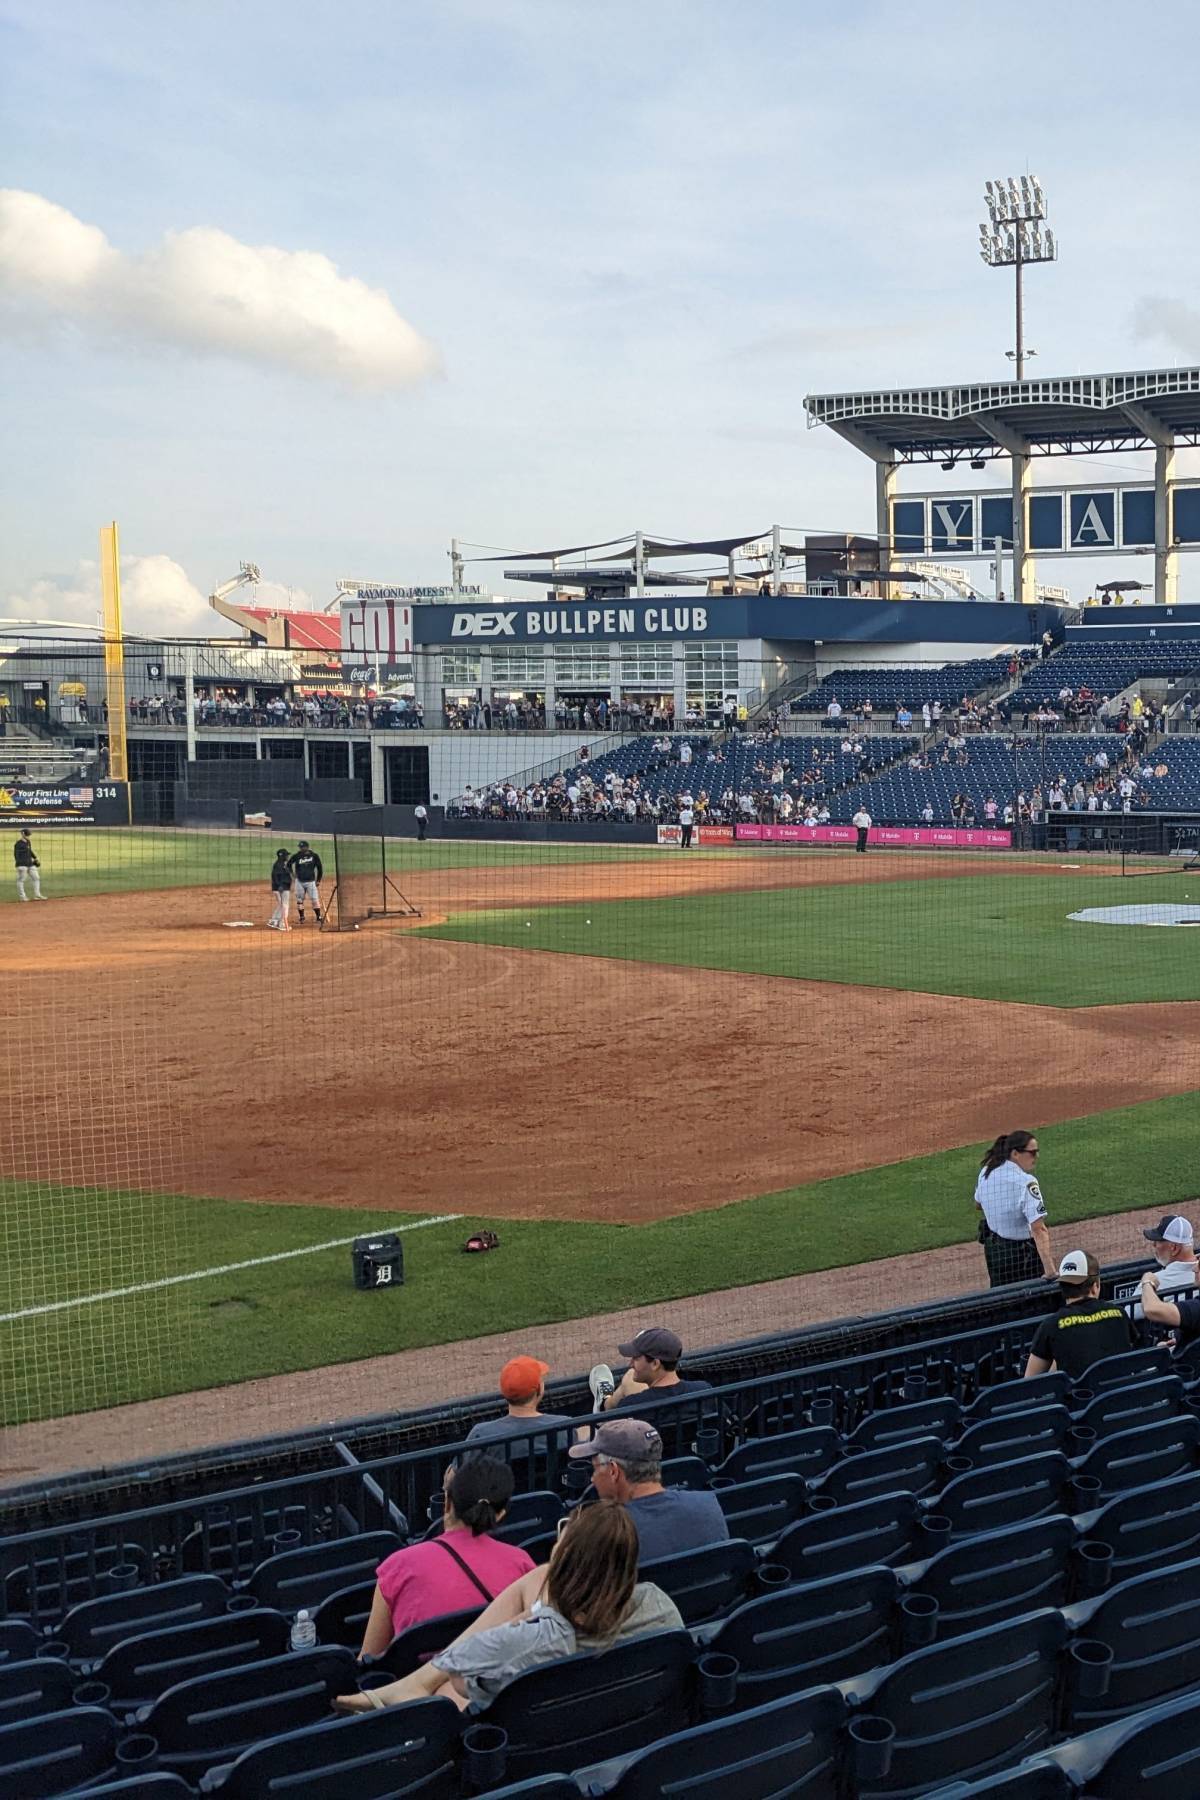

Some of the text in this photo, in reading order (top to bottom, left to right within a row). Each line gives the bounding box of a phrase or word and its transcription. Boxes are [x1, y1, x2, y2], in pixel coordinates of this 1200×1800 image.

[358, 588, 404, 598] RAYMOND
[406, 586, 438, 598] JAMES
[451, 608, 708, 636] DEX BULLPEN CLUB
[36, 789, 52, 797] First
[96, 787, 117, 798] 314
